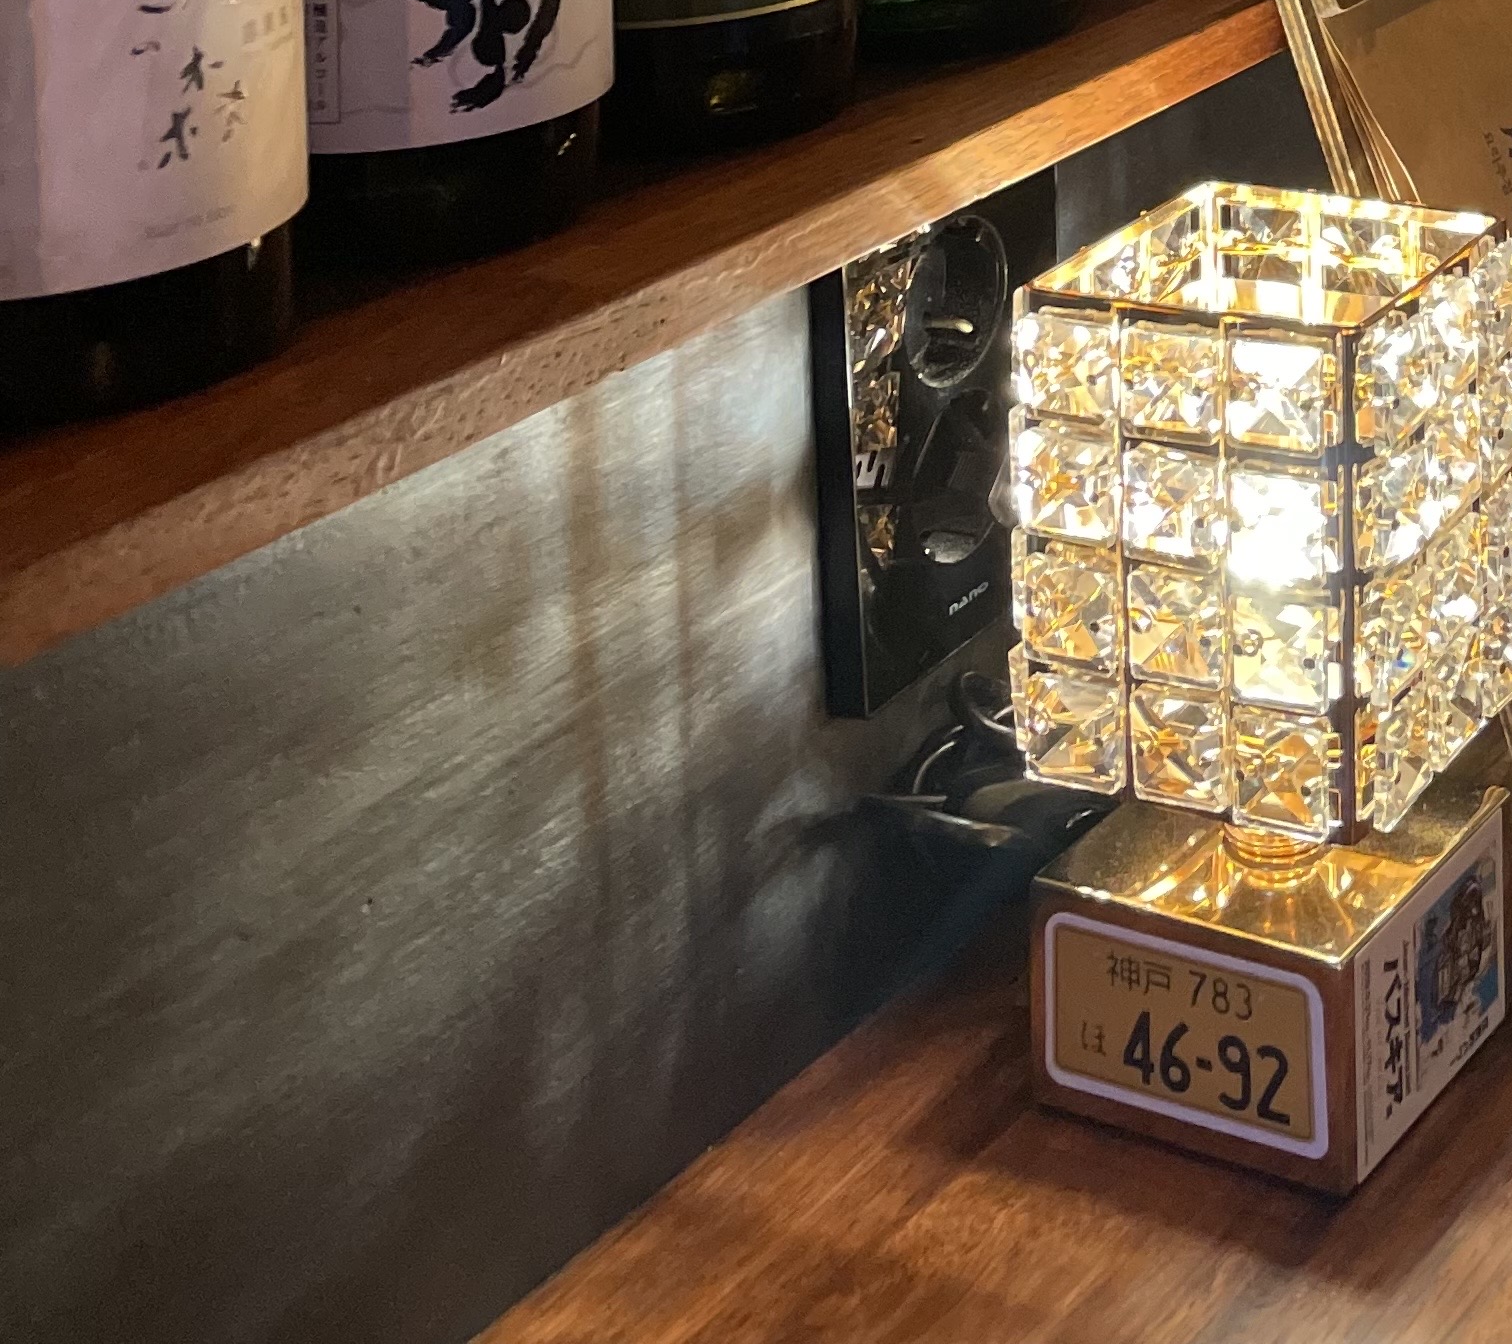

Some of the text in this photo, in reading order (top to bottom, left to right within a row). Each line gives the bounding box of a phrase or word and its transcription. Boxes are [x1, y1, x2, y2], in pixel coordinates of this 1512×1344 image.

[949, 581, 989, 616] nano
[1105, 947, 1254, 1022] 神戸 783
[1080, 1010, 1292, 1126] ほ 46-92
